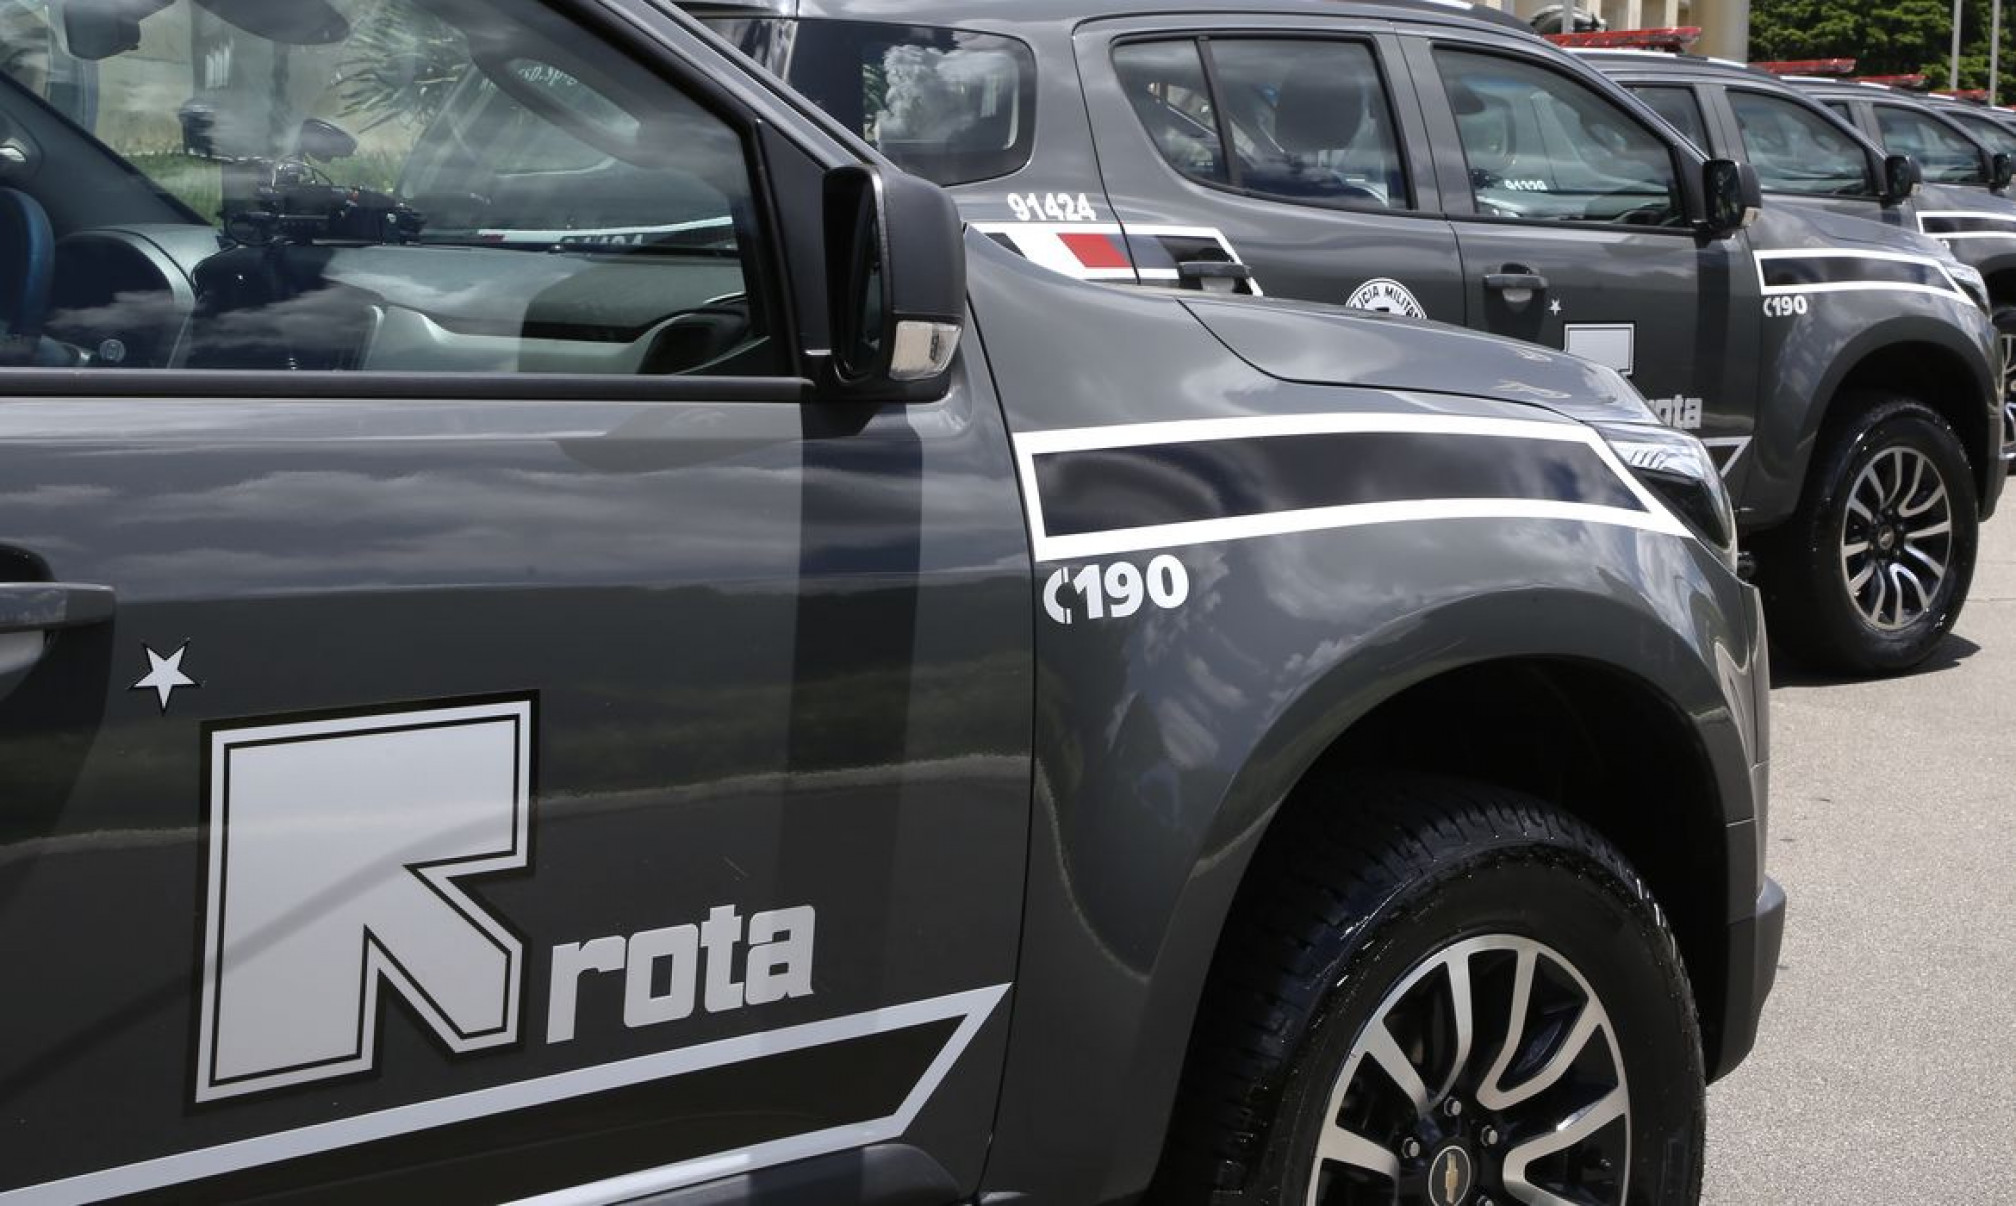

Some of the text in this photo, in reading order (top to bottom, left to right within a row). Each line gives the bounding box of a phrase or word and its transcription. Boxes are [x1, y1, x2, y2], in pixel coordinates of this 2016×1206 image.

[1007, 192, 1097, 221] 91424
[1384, 285, 1420, 318] MILITA
[546, 904, 816, 1045] rota
